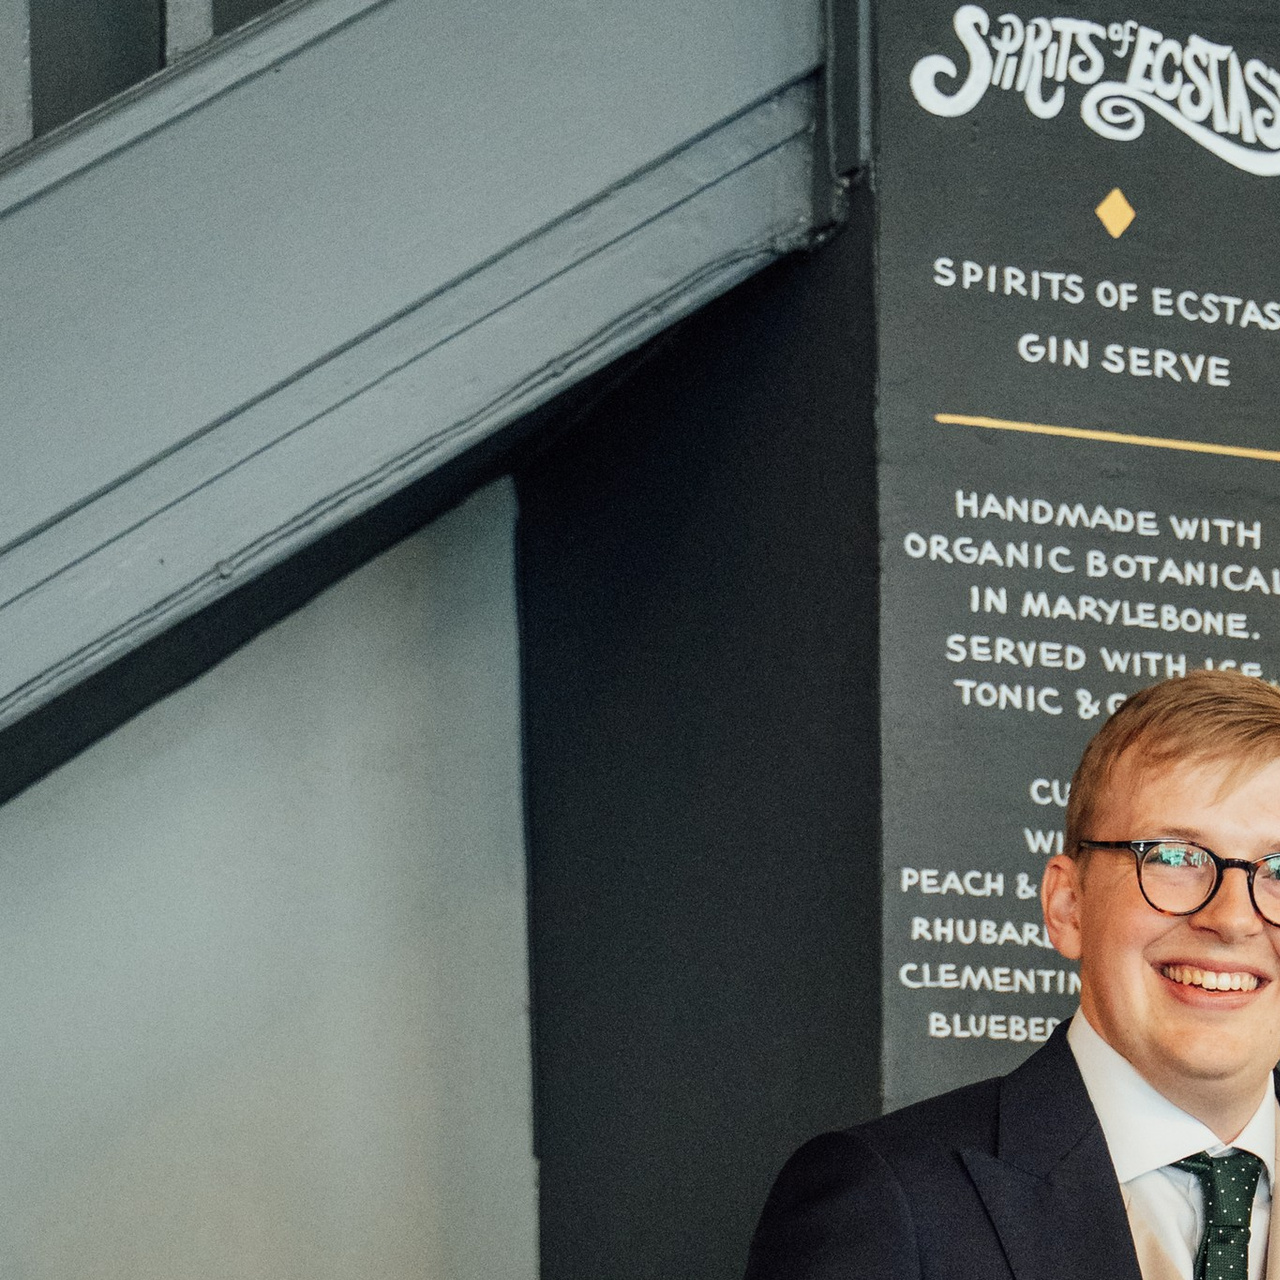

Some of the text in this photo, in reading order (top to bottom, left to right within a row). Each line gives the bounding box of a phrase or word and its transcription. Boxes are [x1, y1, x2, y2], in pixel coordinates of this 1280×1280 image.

[933, 257, 1085, 304] SPIRITS
[1096, 280, 1138, 311] OF
[1017, 333, 1231, 387] GIN SERVE
[955, 489, 1262, 550] HANDMADE WITH
[903, 532, 1075, 574] ORGANIC
[970, 585, 1262, 641] IN MARYLEBONE.
[945, 633, 1087, 670] SERVED
[1100, 646, 1187, 679] WITH
[953, 678, 1063, 715] TONIC
[1075, 688, 1100, 720] &
[900, 867, 1038, 900] PEACH &
[898, 962, 1082, 995] CLEMENTIN
[928, 1011, 1061, 1043] BLUEBE
